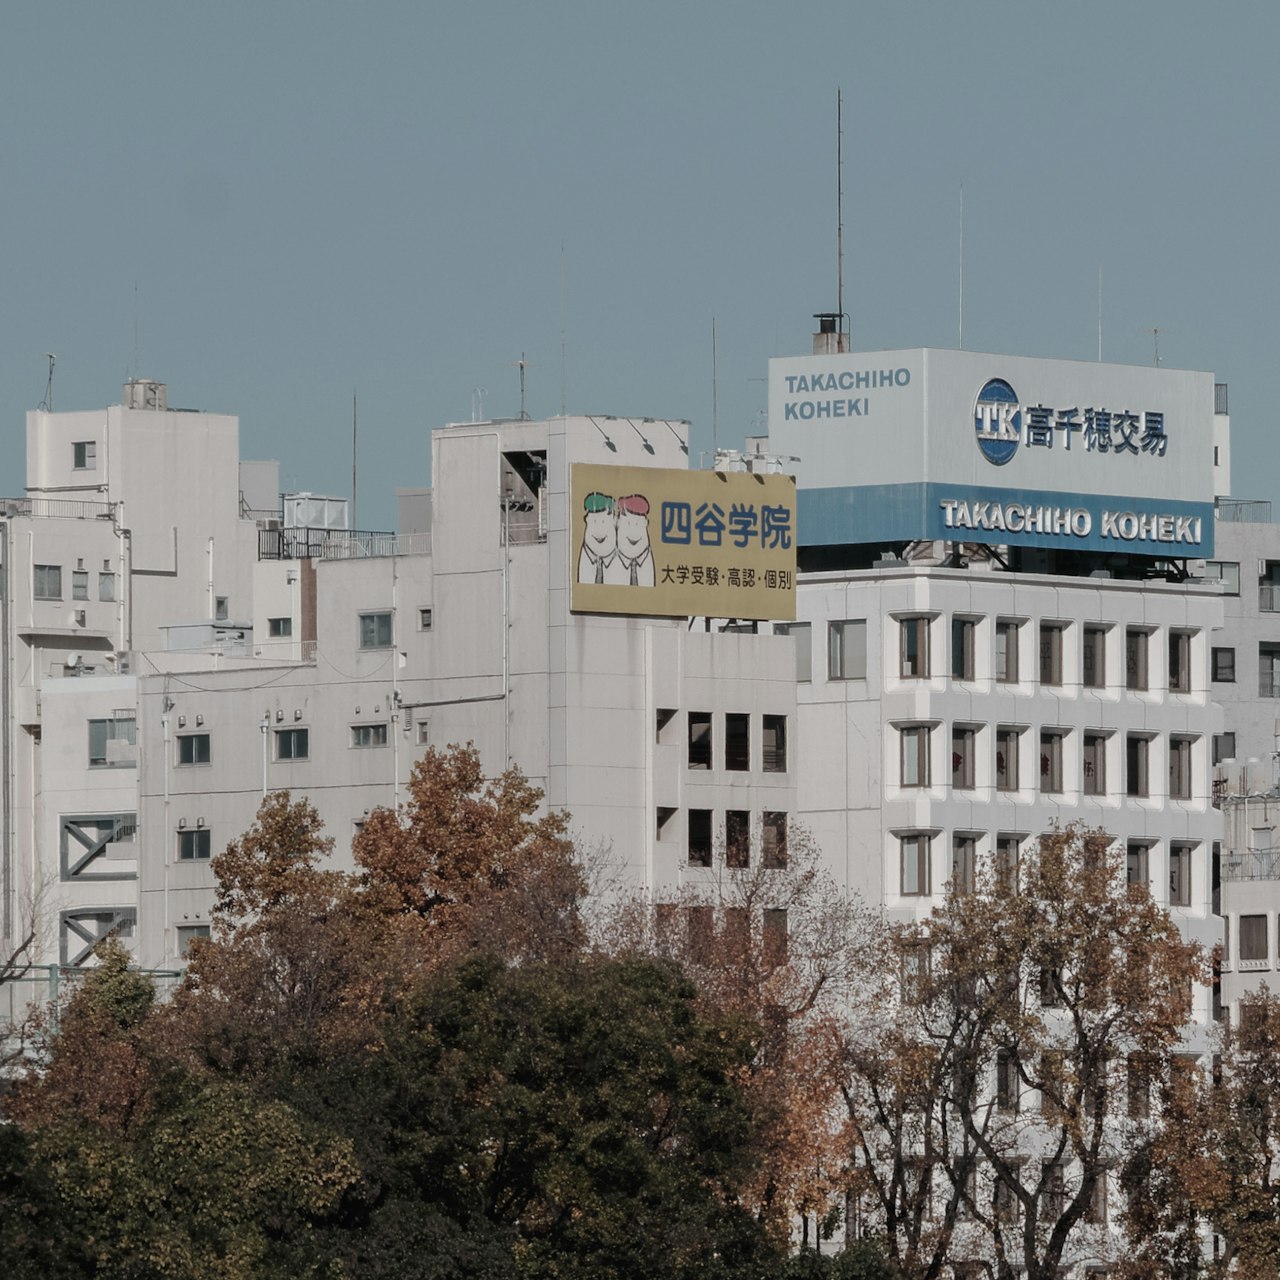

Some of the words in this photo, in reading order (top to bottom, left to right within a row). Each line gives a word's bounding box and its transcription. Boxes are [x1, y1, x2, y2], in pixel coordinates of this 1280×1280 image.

[785, 367, 911, 393] TAKACHIHO
[784, 398, 869, 420] KOHEKI
[1023, 404, 1168, 457] 高千穂交易
[661, 501, 792, 550] 四谷学院
[940, 500, 1092, 537] TAKACHIHO
[1101, 511, 1202, 544] KOHEKI
